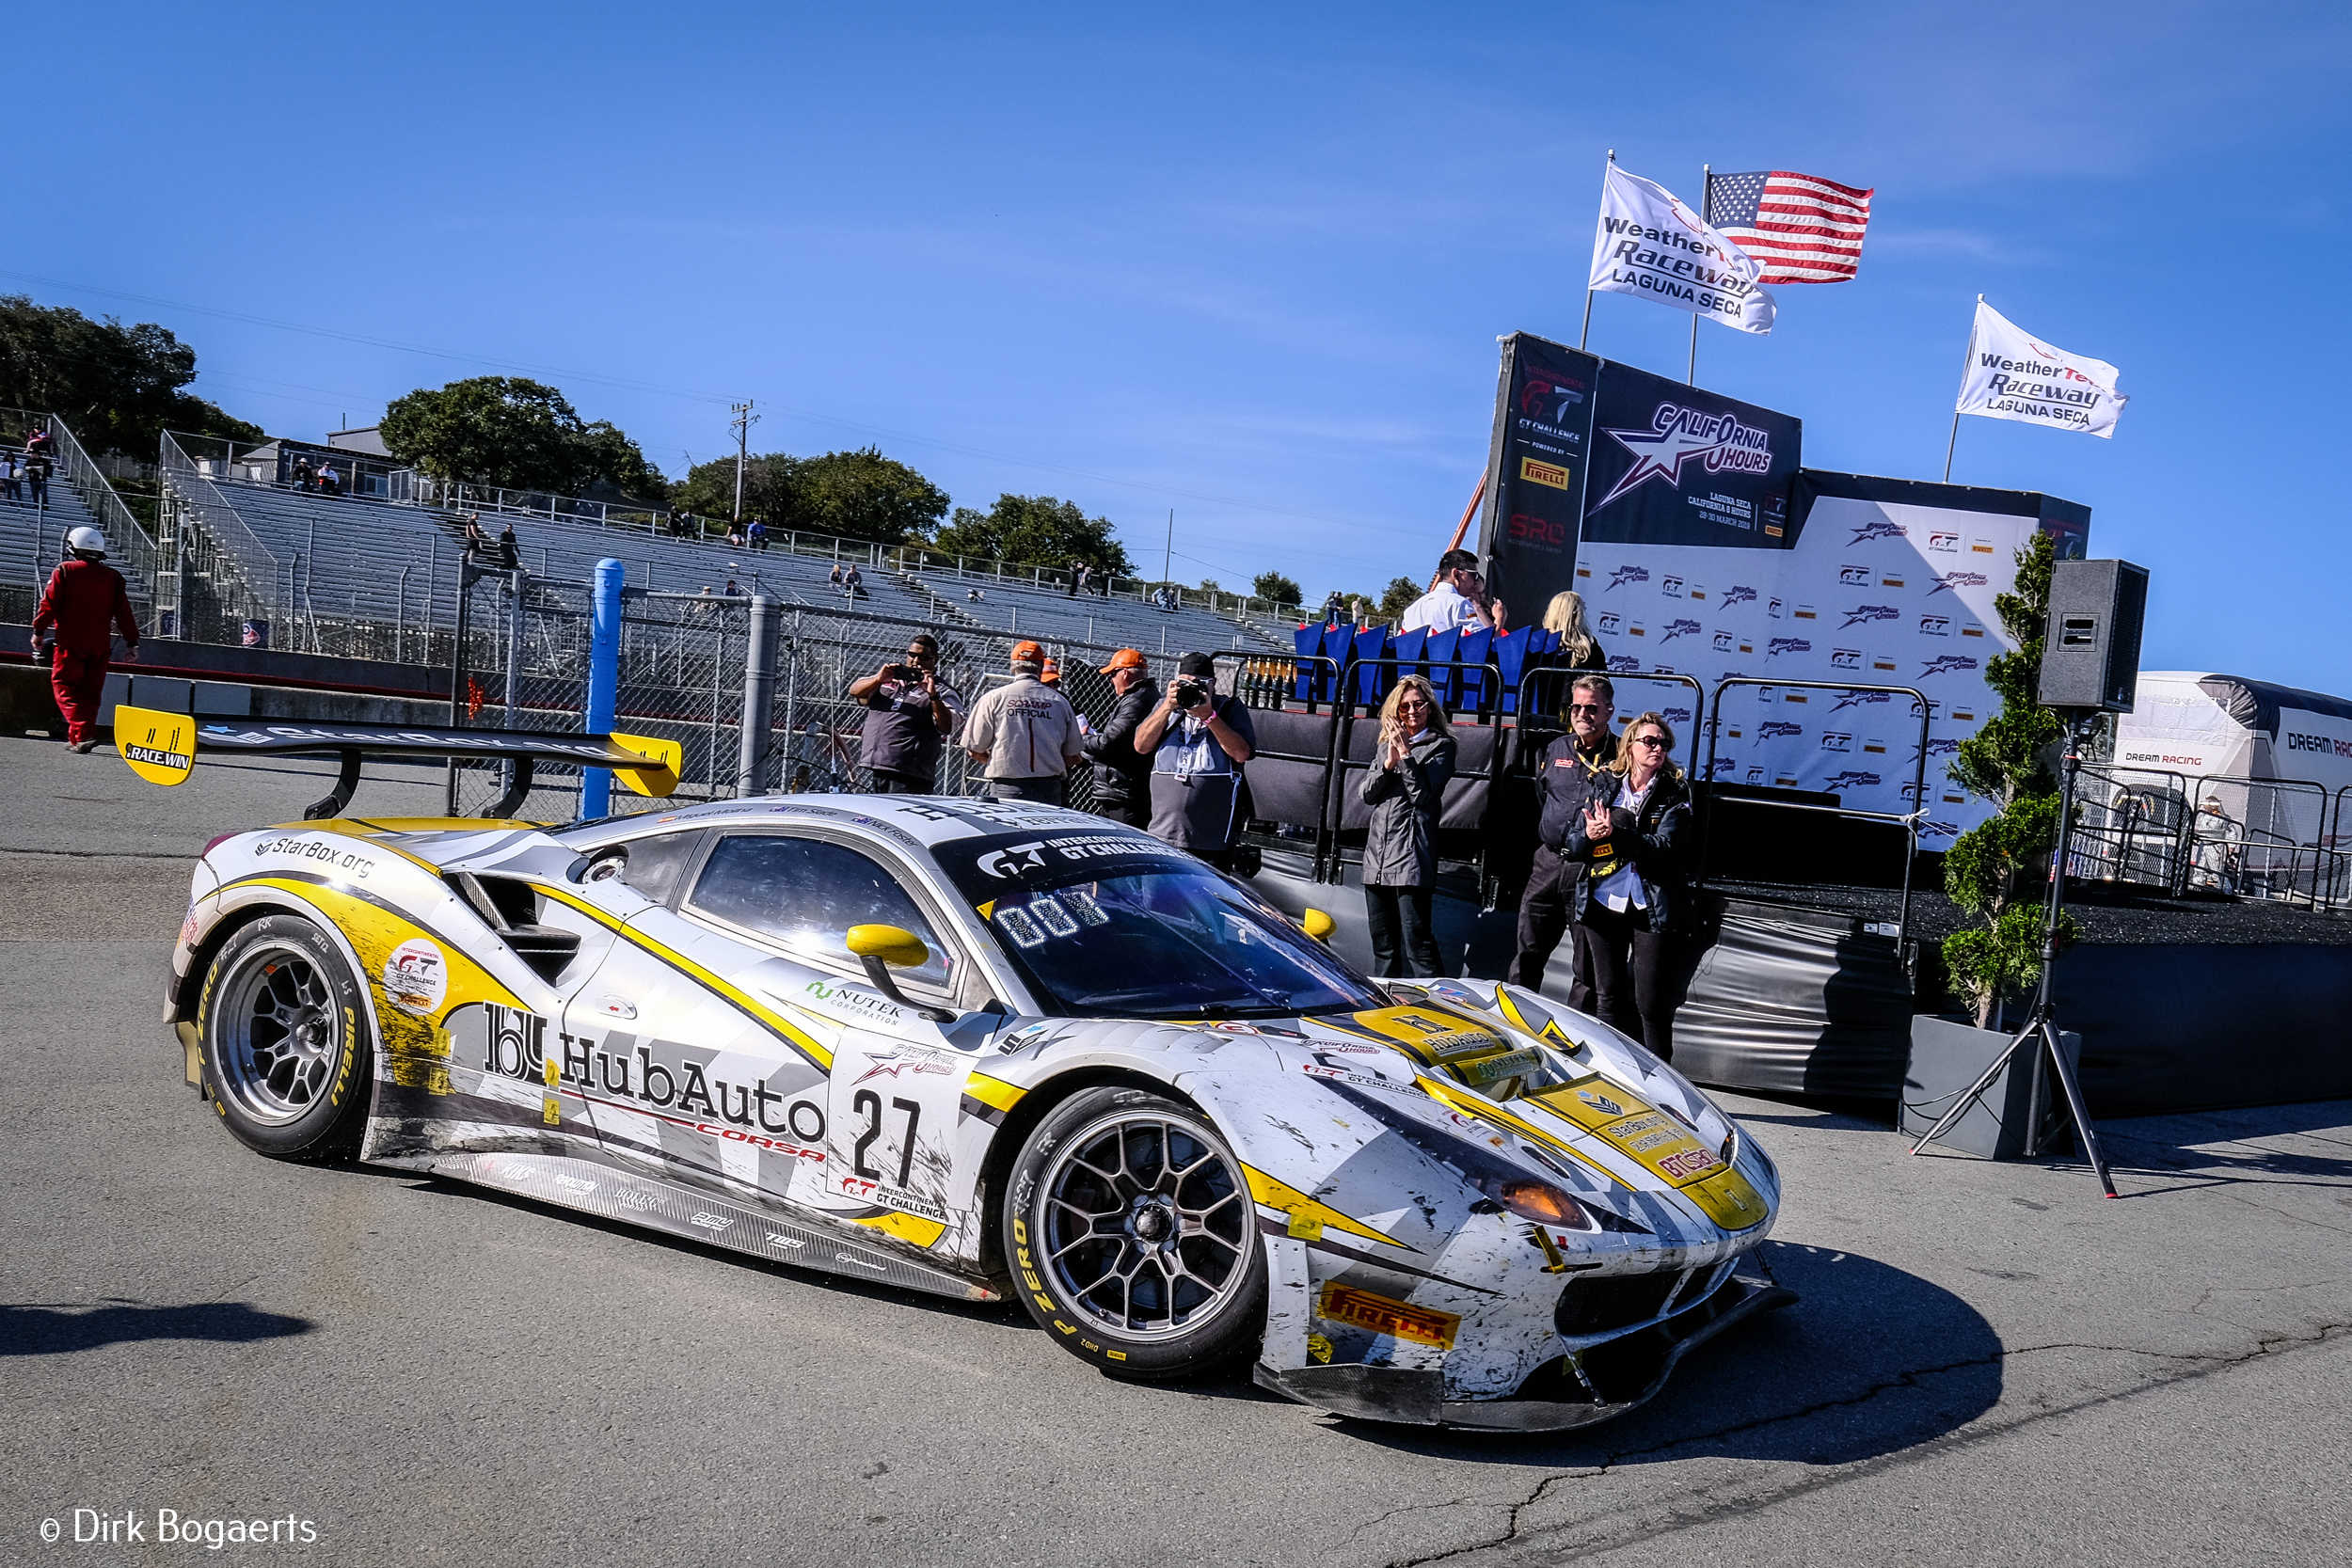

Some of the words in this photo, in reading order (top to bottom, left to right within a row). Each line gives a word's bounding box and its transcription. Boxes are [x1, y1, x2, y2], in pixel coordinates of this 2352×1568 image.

[1604, 216, 1725, 261] Weather
[1613, 240, 1755, 299] Raceway
[1613, 268, 1694, 302] LAGUNA
[1698, 293, 1741, 319] SECA
[1981, 353, 2094, 387] WeatherTe
[1988, 373, 2101, 409] Raceway
[1987, 398, 2050, 418] LAGUNA
[2053, 408, 2090, 425] SECA
[1653, 403, 1770, 453] CALIFORNIA
[1526, 461, 1565, 485] PIRELLI
[1688, 496, 1725, 513] CALIFORNIA
[1709, 491, 1736, 506] LAGUNA
[1736, 499, 1752, 510] SECA
[1716, 515, 1737, 527] MARCH
[1007, 708, 1053, 720] OFFICIAL
[2287, 732, 2333, 754] DREAM
[2125, 752, 2160, 763] DREAM
[2162, 754, 2202, 766] RACING
[868, 818, 890, 834] Nick
[889, 829, 920, 847] Foster
[273, 837, 375, 879] StarBox.org
[1058, 846, 1091, 861] GT
[831, 999, 898, 1026] CORPORATION
[836, 989, 904, 1019] NUTEK
[330, 1006, 357, 1108] PIRELLI
[558, 1032, 827, 1144] HubAuto
[693, 1123, 827, 1163] CORSA
[853, 1088, 921, 1189] 27
[876, 1193, 888, 1204] GT
[890, 1196, 946, 1221] CHALLENGE
[766, 1232, 806, 1249] TWS
[1012, 1218, 1057, 1314] ZERO
[1329, 1289, 1450, 1340] PIRELLI
